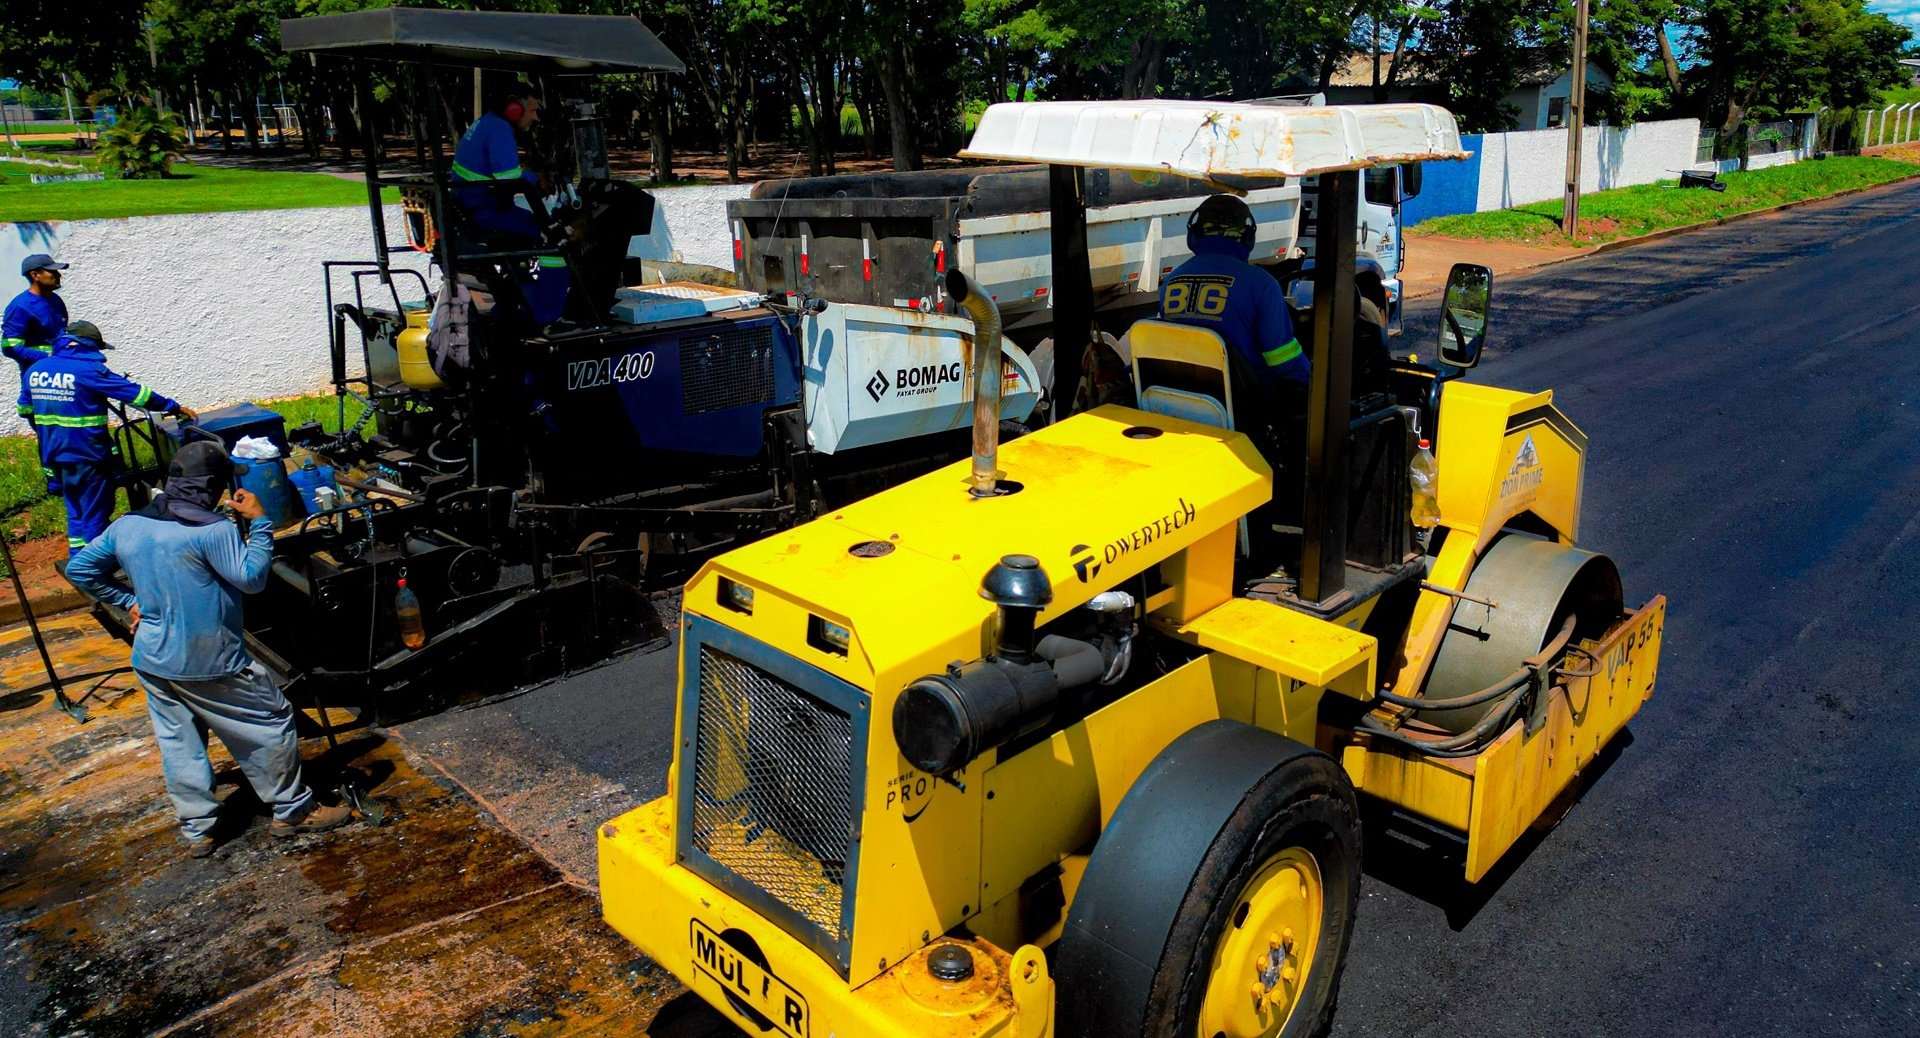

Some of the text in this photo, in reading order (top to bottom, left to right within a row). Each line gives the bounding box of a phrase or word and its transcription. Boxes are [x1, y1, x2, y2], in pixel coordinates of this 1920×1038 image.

[568, 351, 654, 390] VDA 400
[896, 362, 960, 389] BOMAG
[896, 386, 938, 397] FAYAT GROUP
[1638, 613, 1655, 650] 55
[886, 765, 966, 811] PROTN
[887, 770, 914, 788] SERIE
[696, 929, 803, 1036] MÜLR
